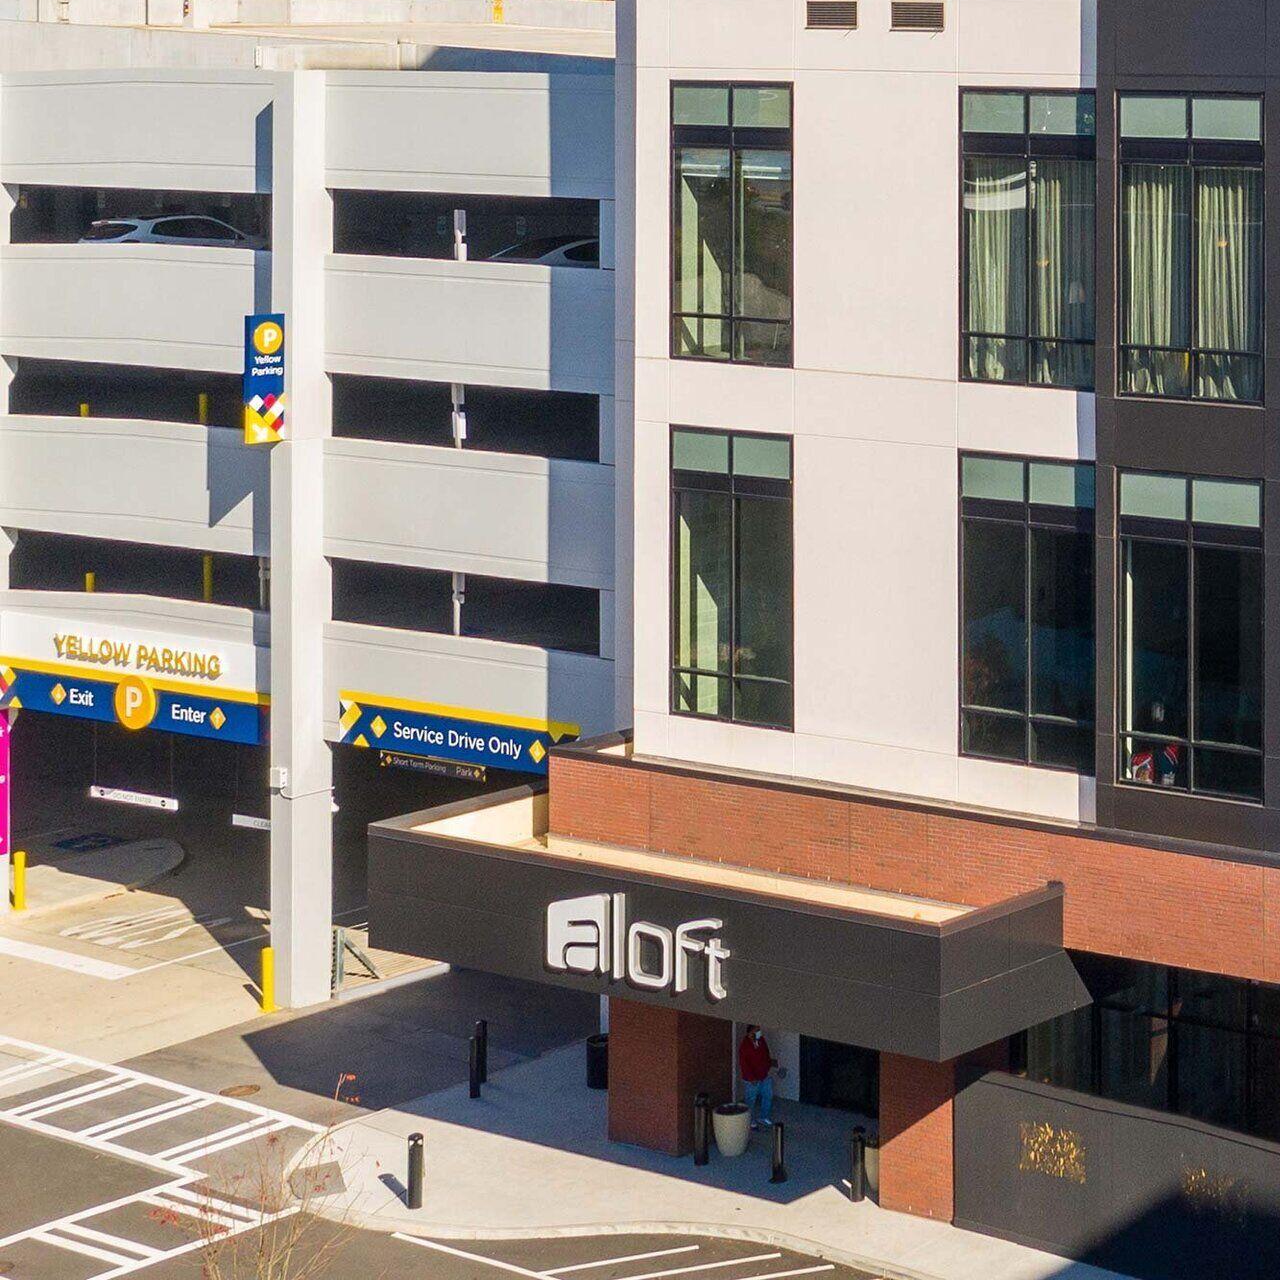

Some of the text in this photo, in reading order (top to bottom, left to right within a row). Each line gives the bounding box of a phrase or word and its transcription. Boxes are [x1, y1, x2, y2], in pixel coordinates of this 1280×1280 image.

[254, 354, 282, 365] Yellow
[251, 366, 284, 377] Parking
[53, 633, 222, 680] YELLOW PARKING
[69, 688, 94, 707] Exit
[171, 704, 206, 723] Enter
[393, 721, 522, 761] Service Drive Only
[392, 756, 409, 766] Short
[455, 766, 474, 778] Park
[546, 891, 731, 1002] aloft
